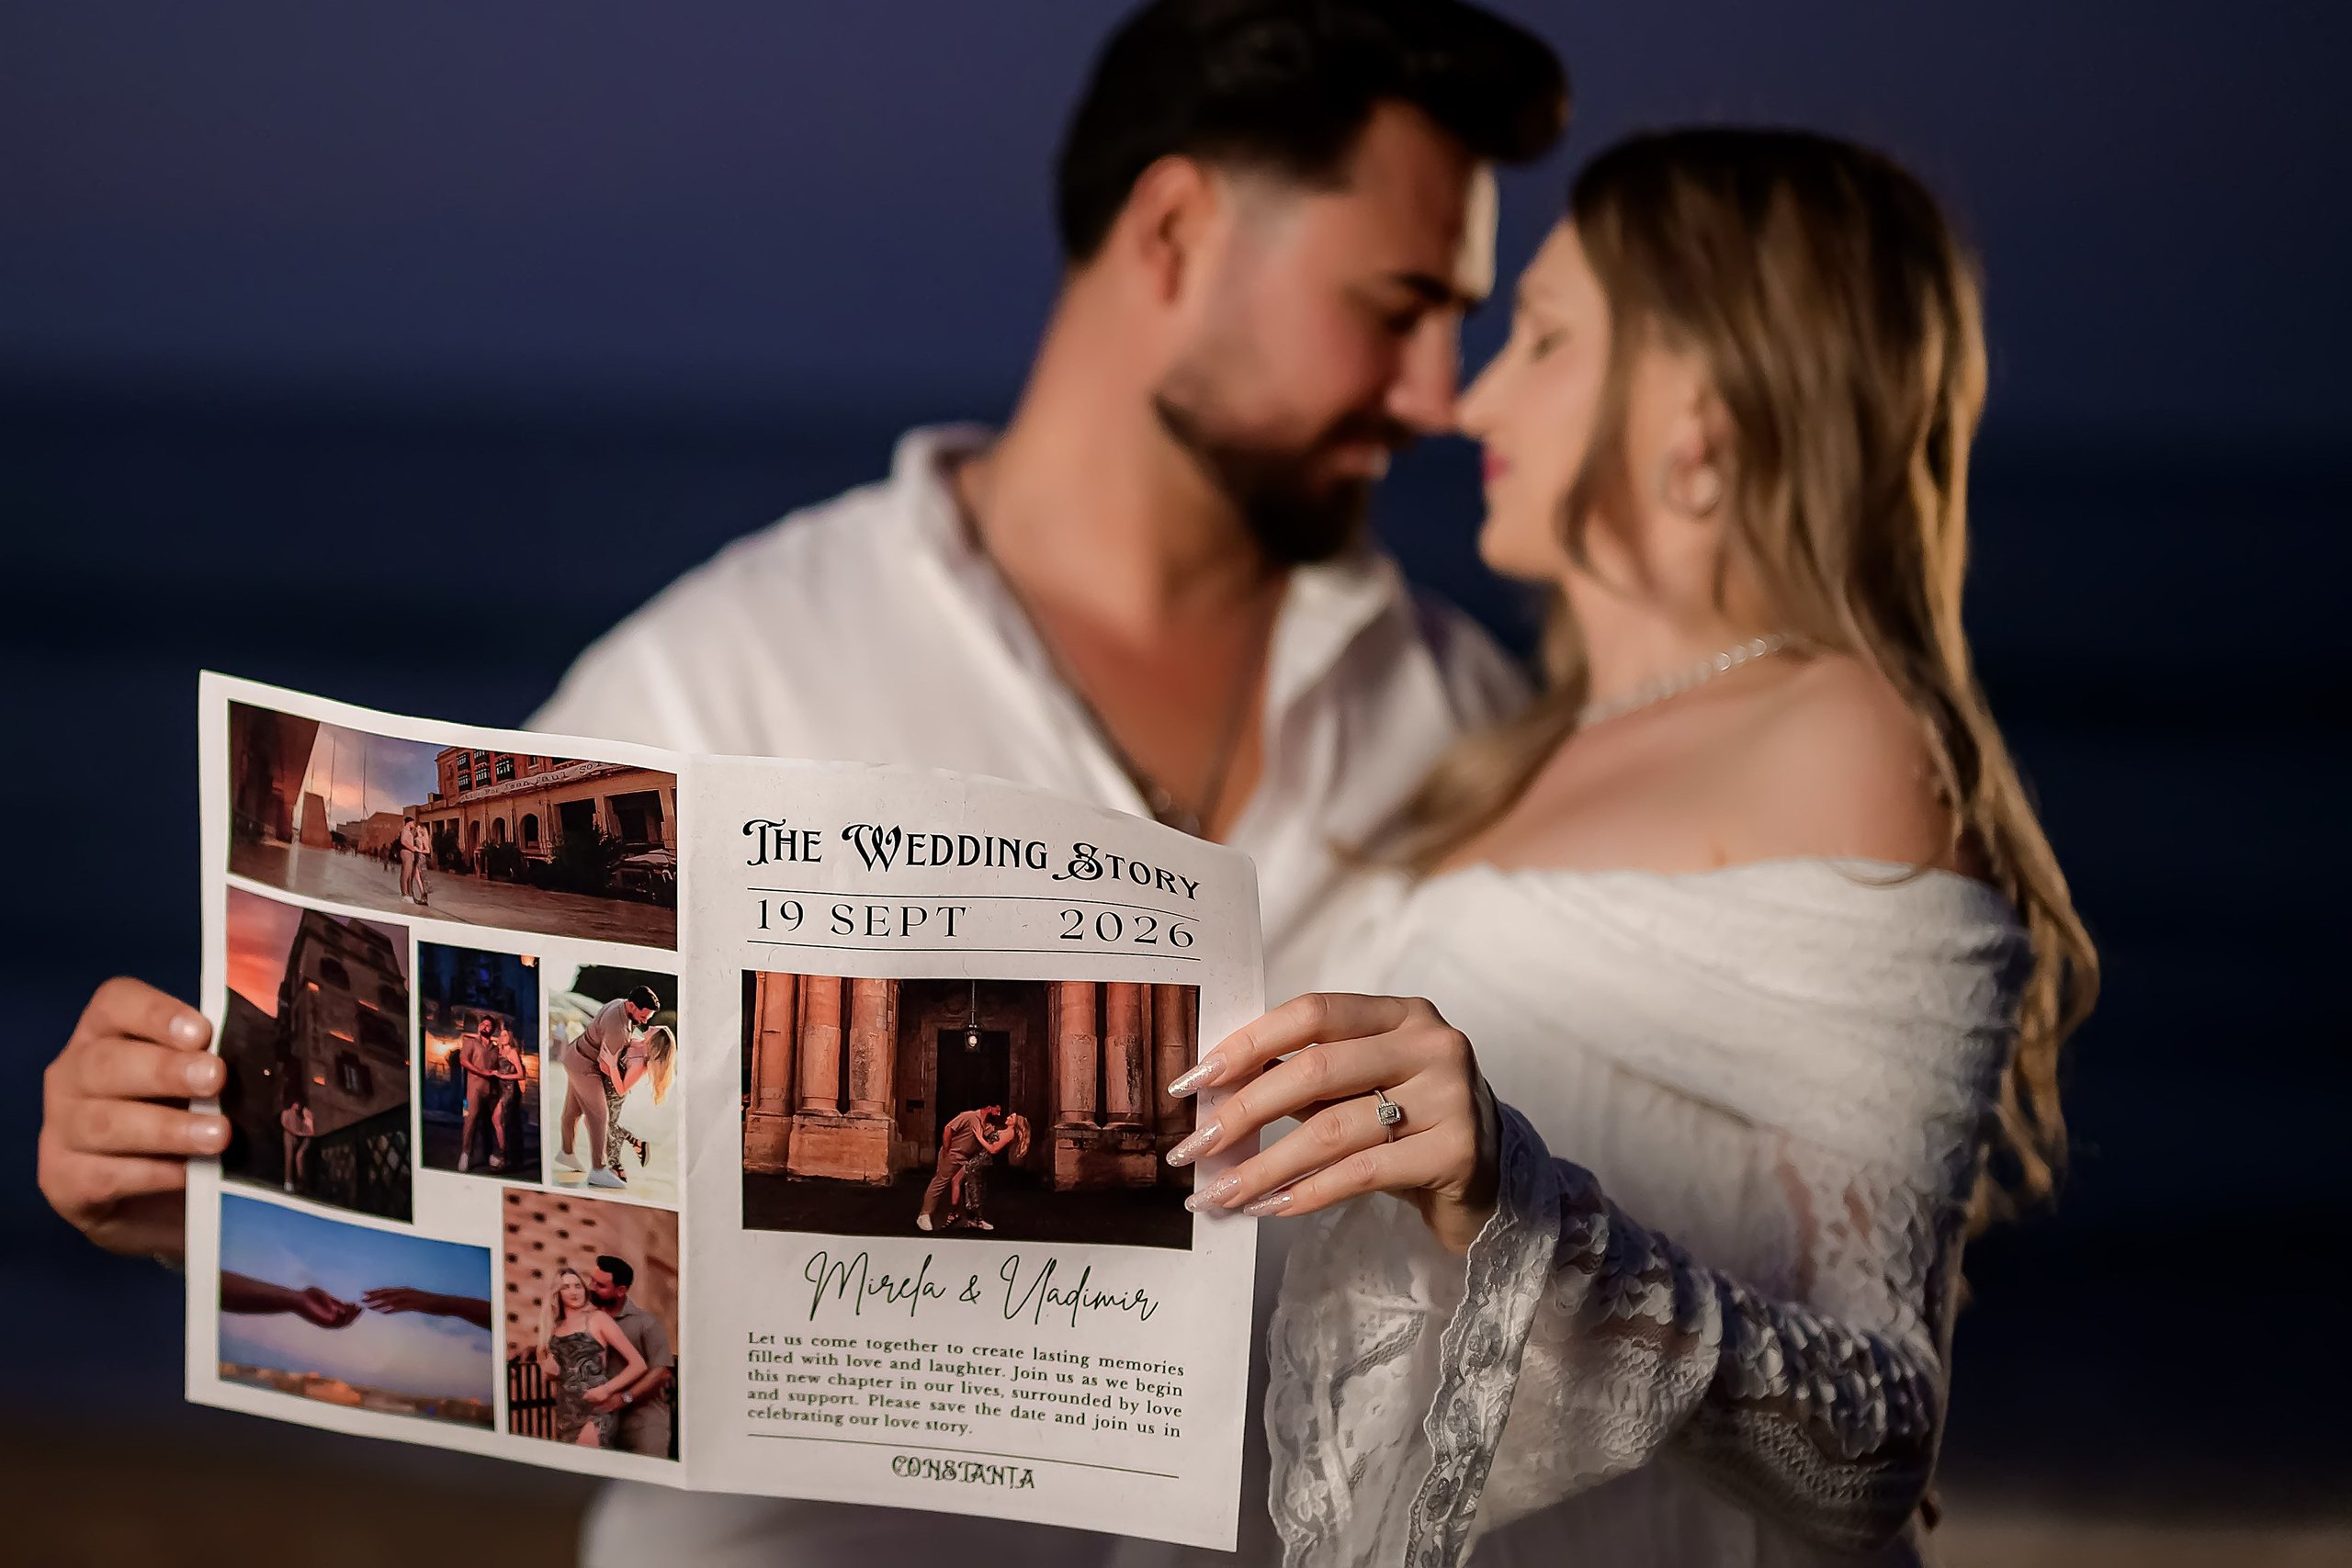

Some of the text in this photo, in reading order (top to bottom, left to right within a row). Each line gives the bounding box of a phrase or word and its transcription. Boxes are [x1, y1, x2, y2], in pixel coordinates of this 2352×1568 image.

[742, 818, 1201, 900] THE WEDDING STORY
[757, 897, 1194, 948] 19 SEPT 2026
[804, 1251, 1159, 1327] Mirela & Vladimir
[748, 1349, 1182, 1397] filled with love and laughter. Join us as we begin
[749, 1332, 1184, 1376] Let us come together to create lasting memories
[747, 1389, 1181, 1438] and support. Please save the date and join us in
[748, 1370, 1182, 1417] this new chapter in our lives, surrounded by love
[747, 1404, 972, 1436] celebrating our love story.
